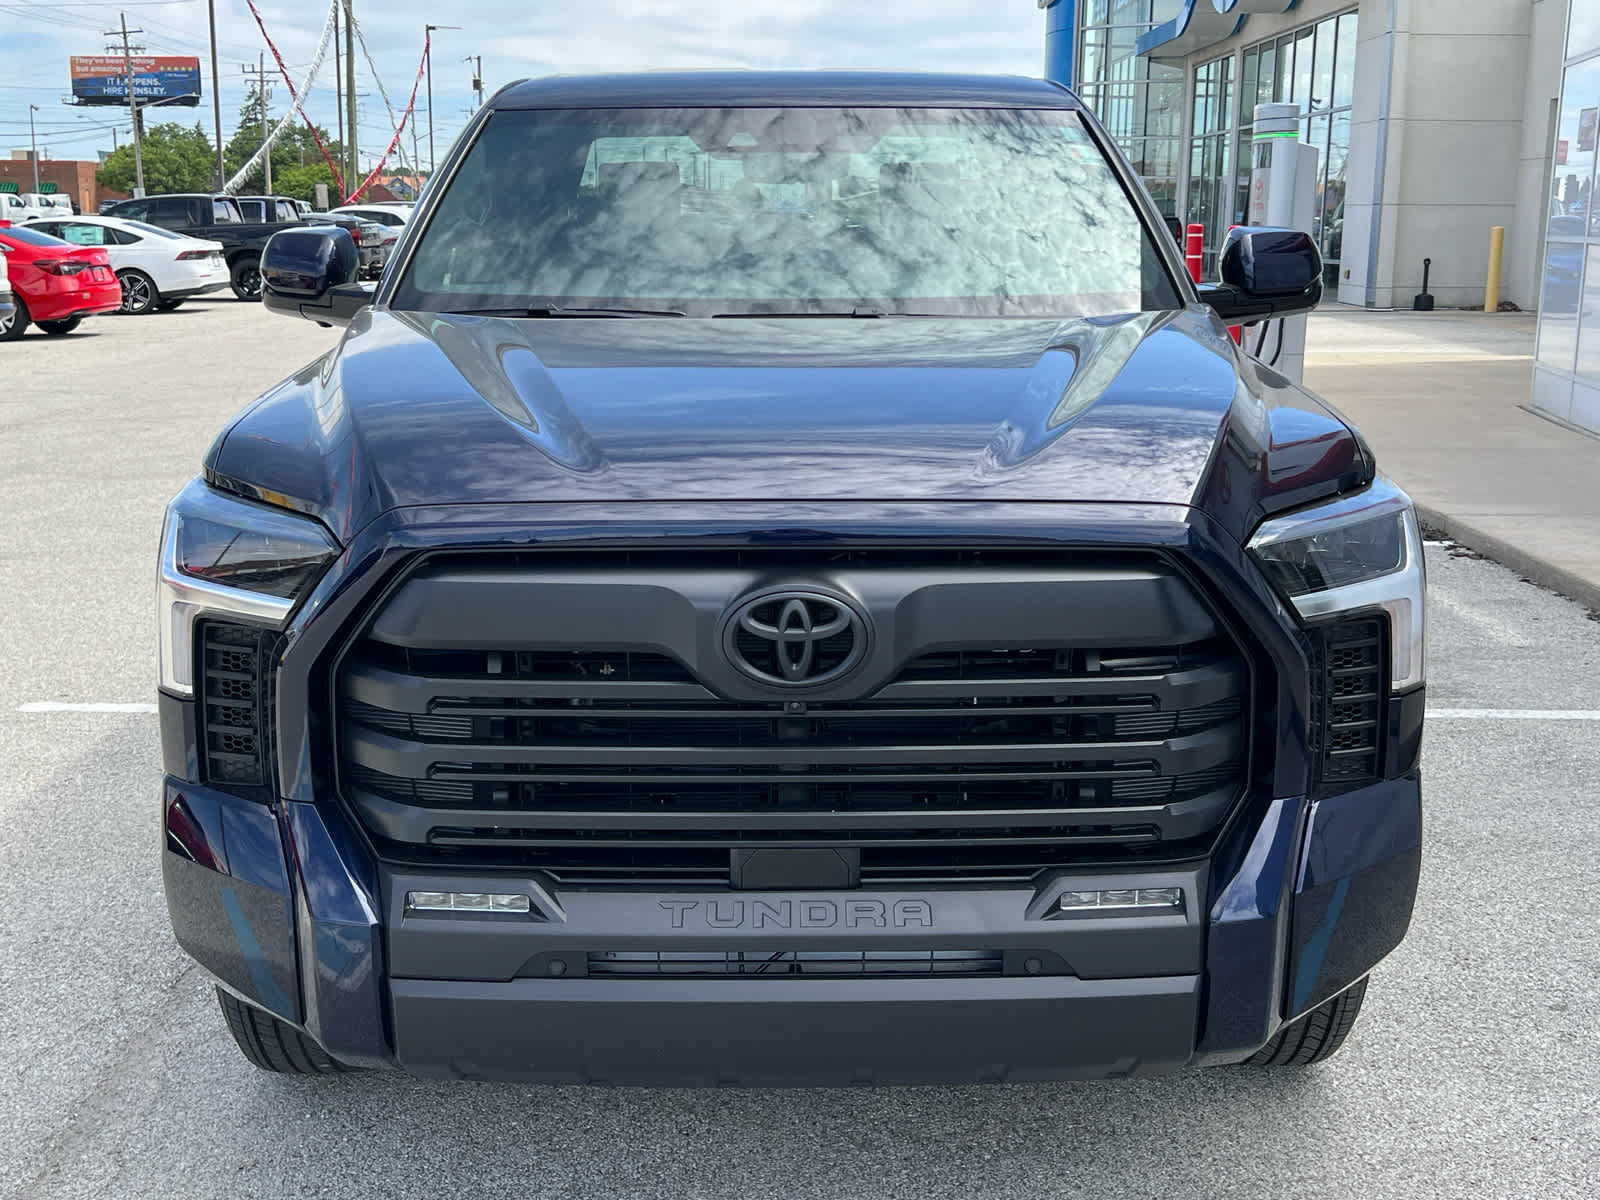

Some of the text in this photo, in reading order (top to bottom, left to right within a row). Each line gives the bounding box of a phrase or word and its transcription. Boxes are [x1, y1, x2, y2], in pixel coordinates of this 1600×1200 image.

[107, 78, 114, 86] IT
[103, 87, 123, 95] HIRE
[658, 900, 933, 928] TUNDRA
